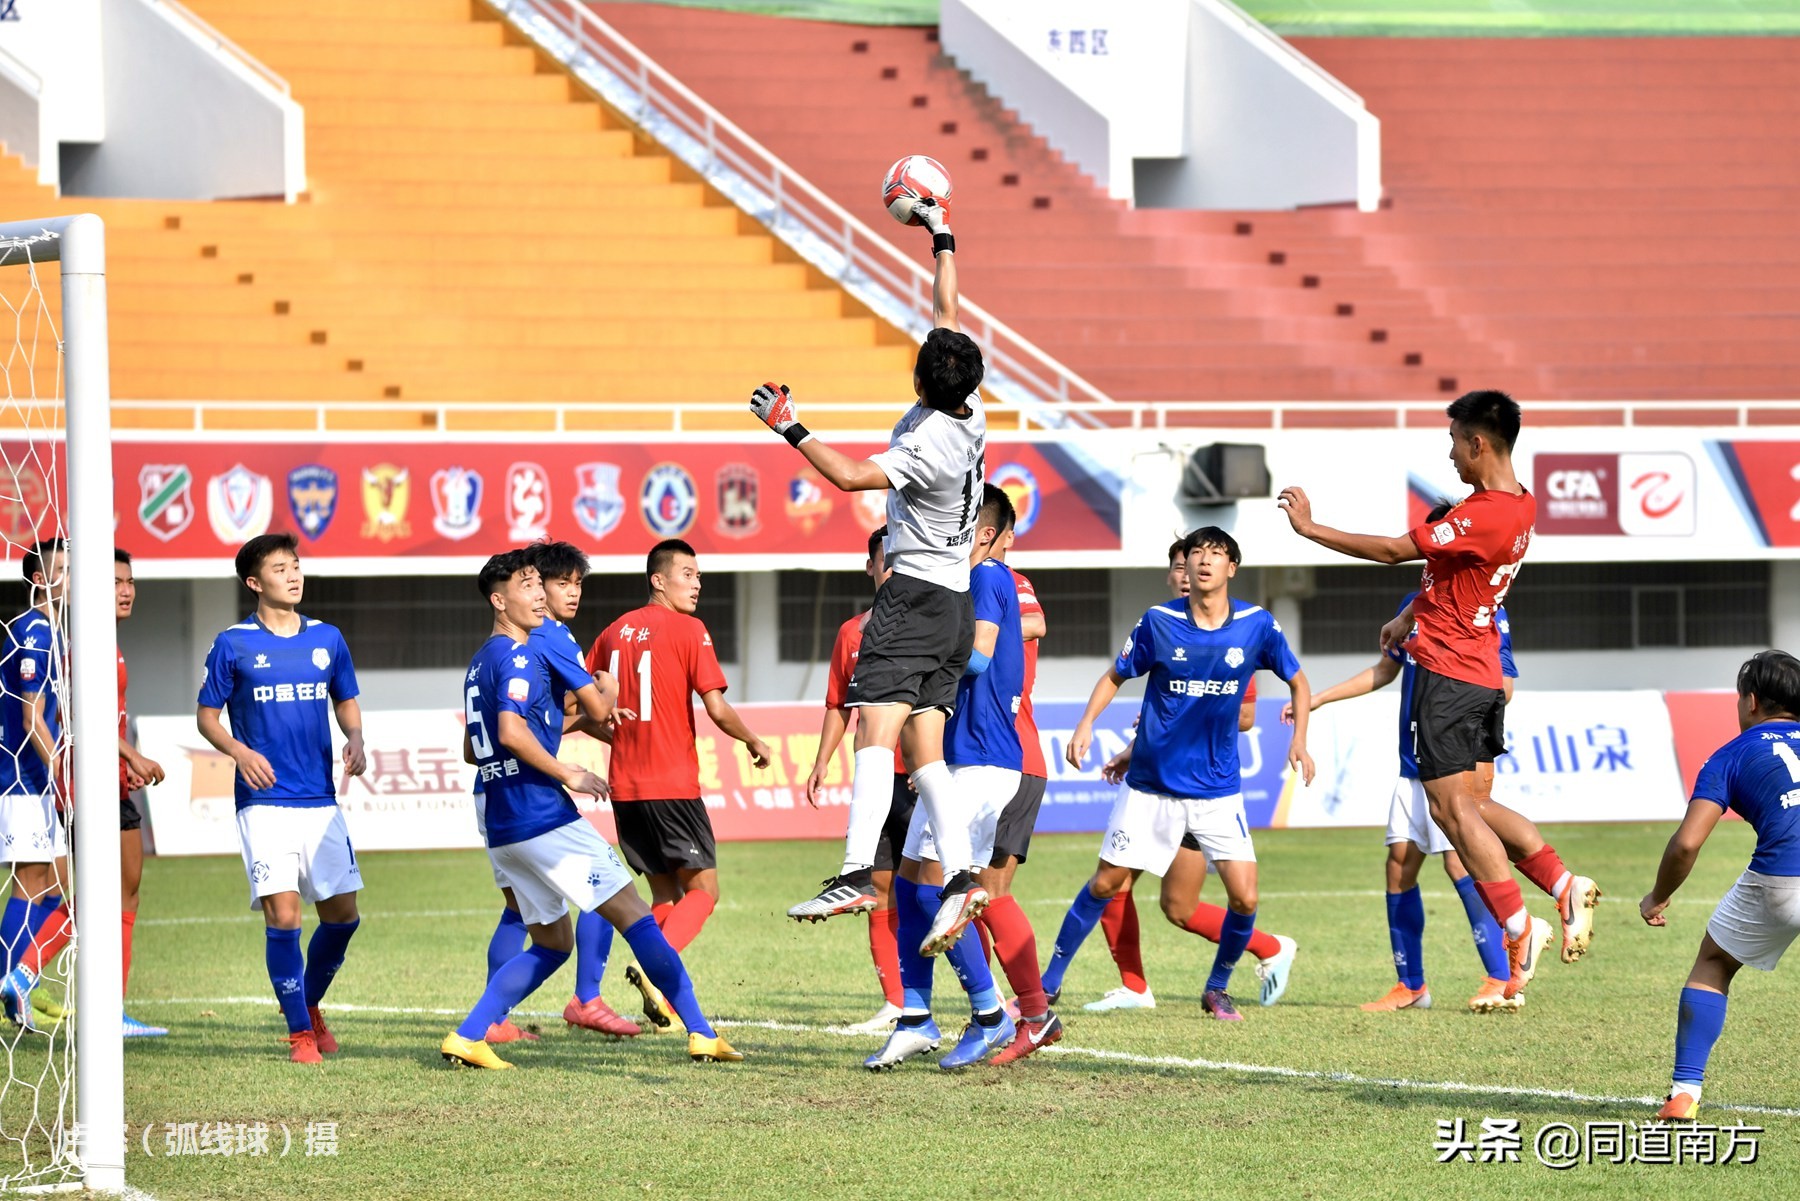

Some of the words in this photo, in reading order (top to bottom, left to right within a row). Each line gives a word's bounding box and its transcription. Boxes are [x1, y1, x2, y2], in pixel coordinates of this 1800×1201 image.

[1547, 470, 1602, 499] CFA
[619, 623, 650, 643] 何壮
[253, 682, 328, 703] 中金在线
[1169, 680, 1239, 697] 中金在线
[466, 685, 494, 760] 5
